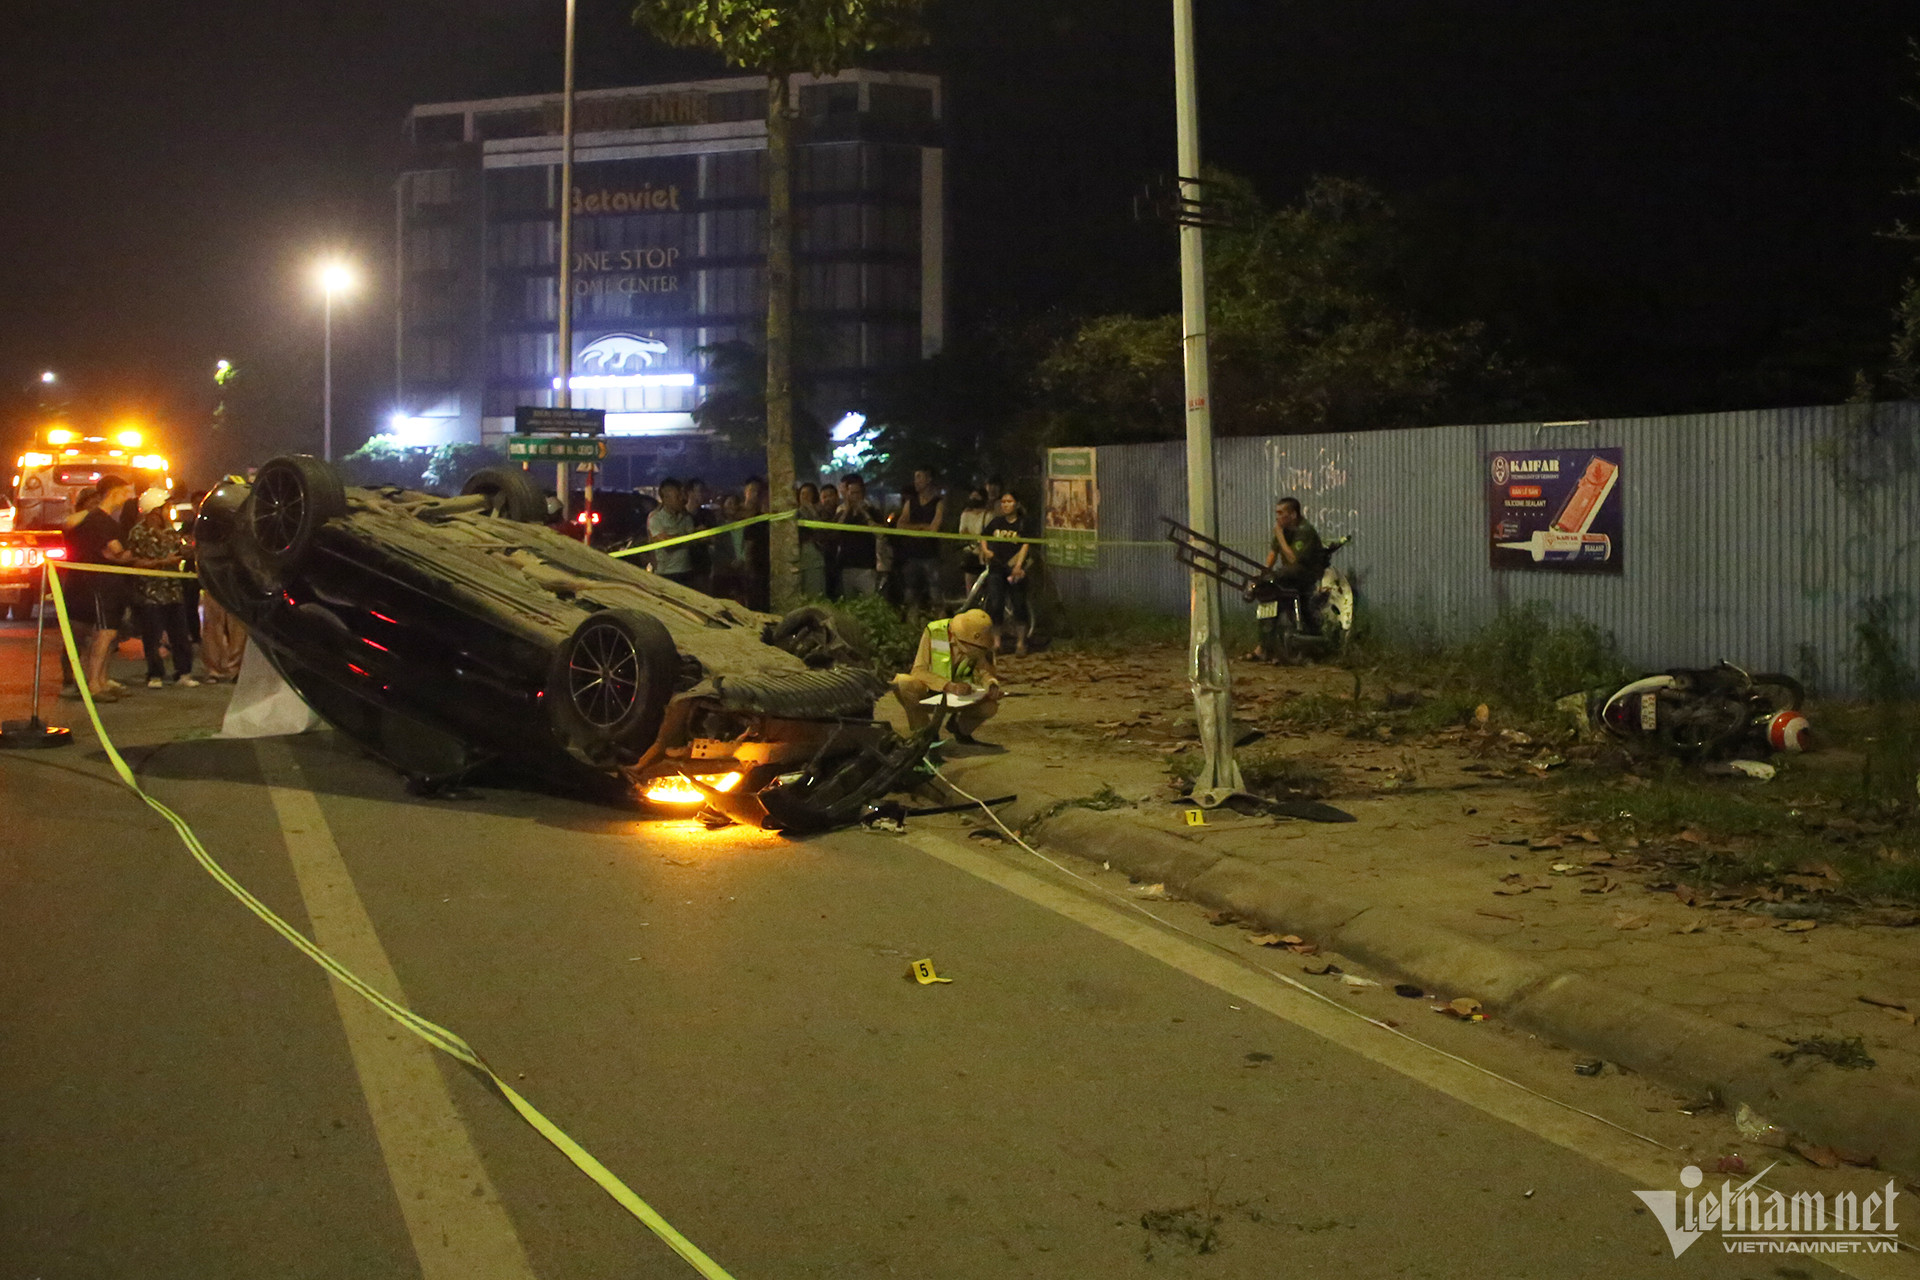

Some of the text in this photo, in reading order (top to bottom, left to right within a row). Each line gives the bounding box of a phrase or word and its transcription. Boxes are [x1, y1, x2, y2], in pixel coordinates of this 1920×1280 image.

[620, 247, 679, 270] STOP
[619, 276, 678, 294] CENTER
[1510, 460, 1560, 472] KAIFAR
[1191, 812, 1197, 822] 7
[919, 963, 929, 977] 5
